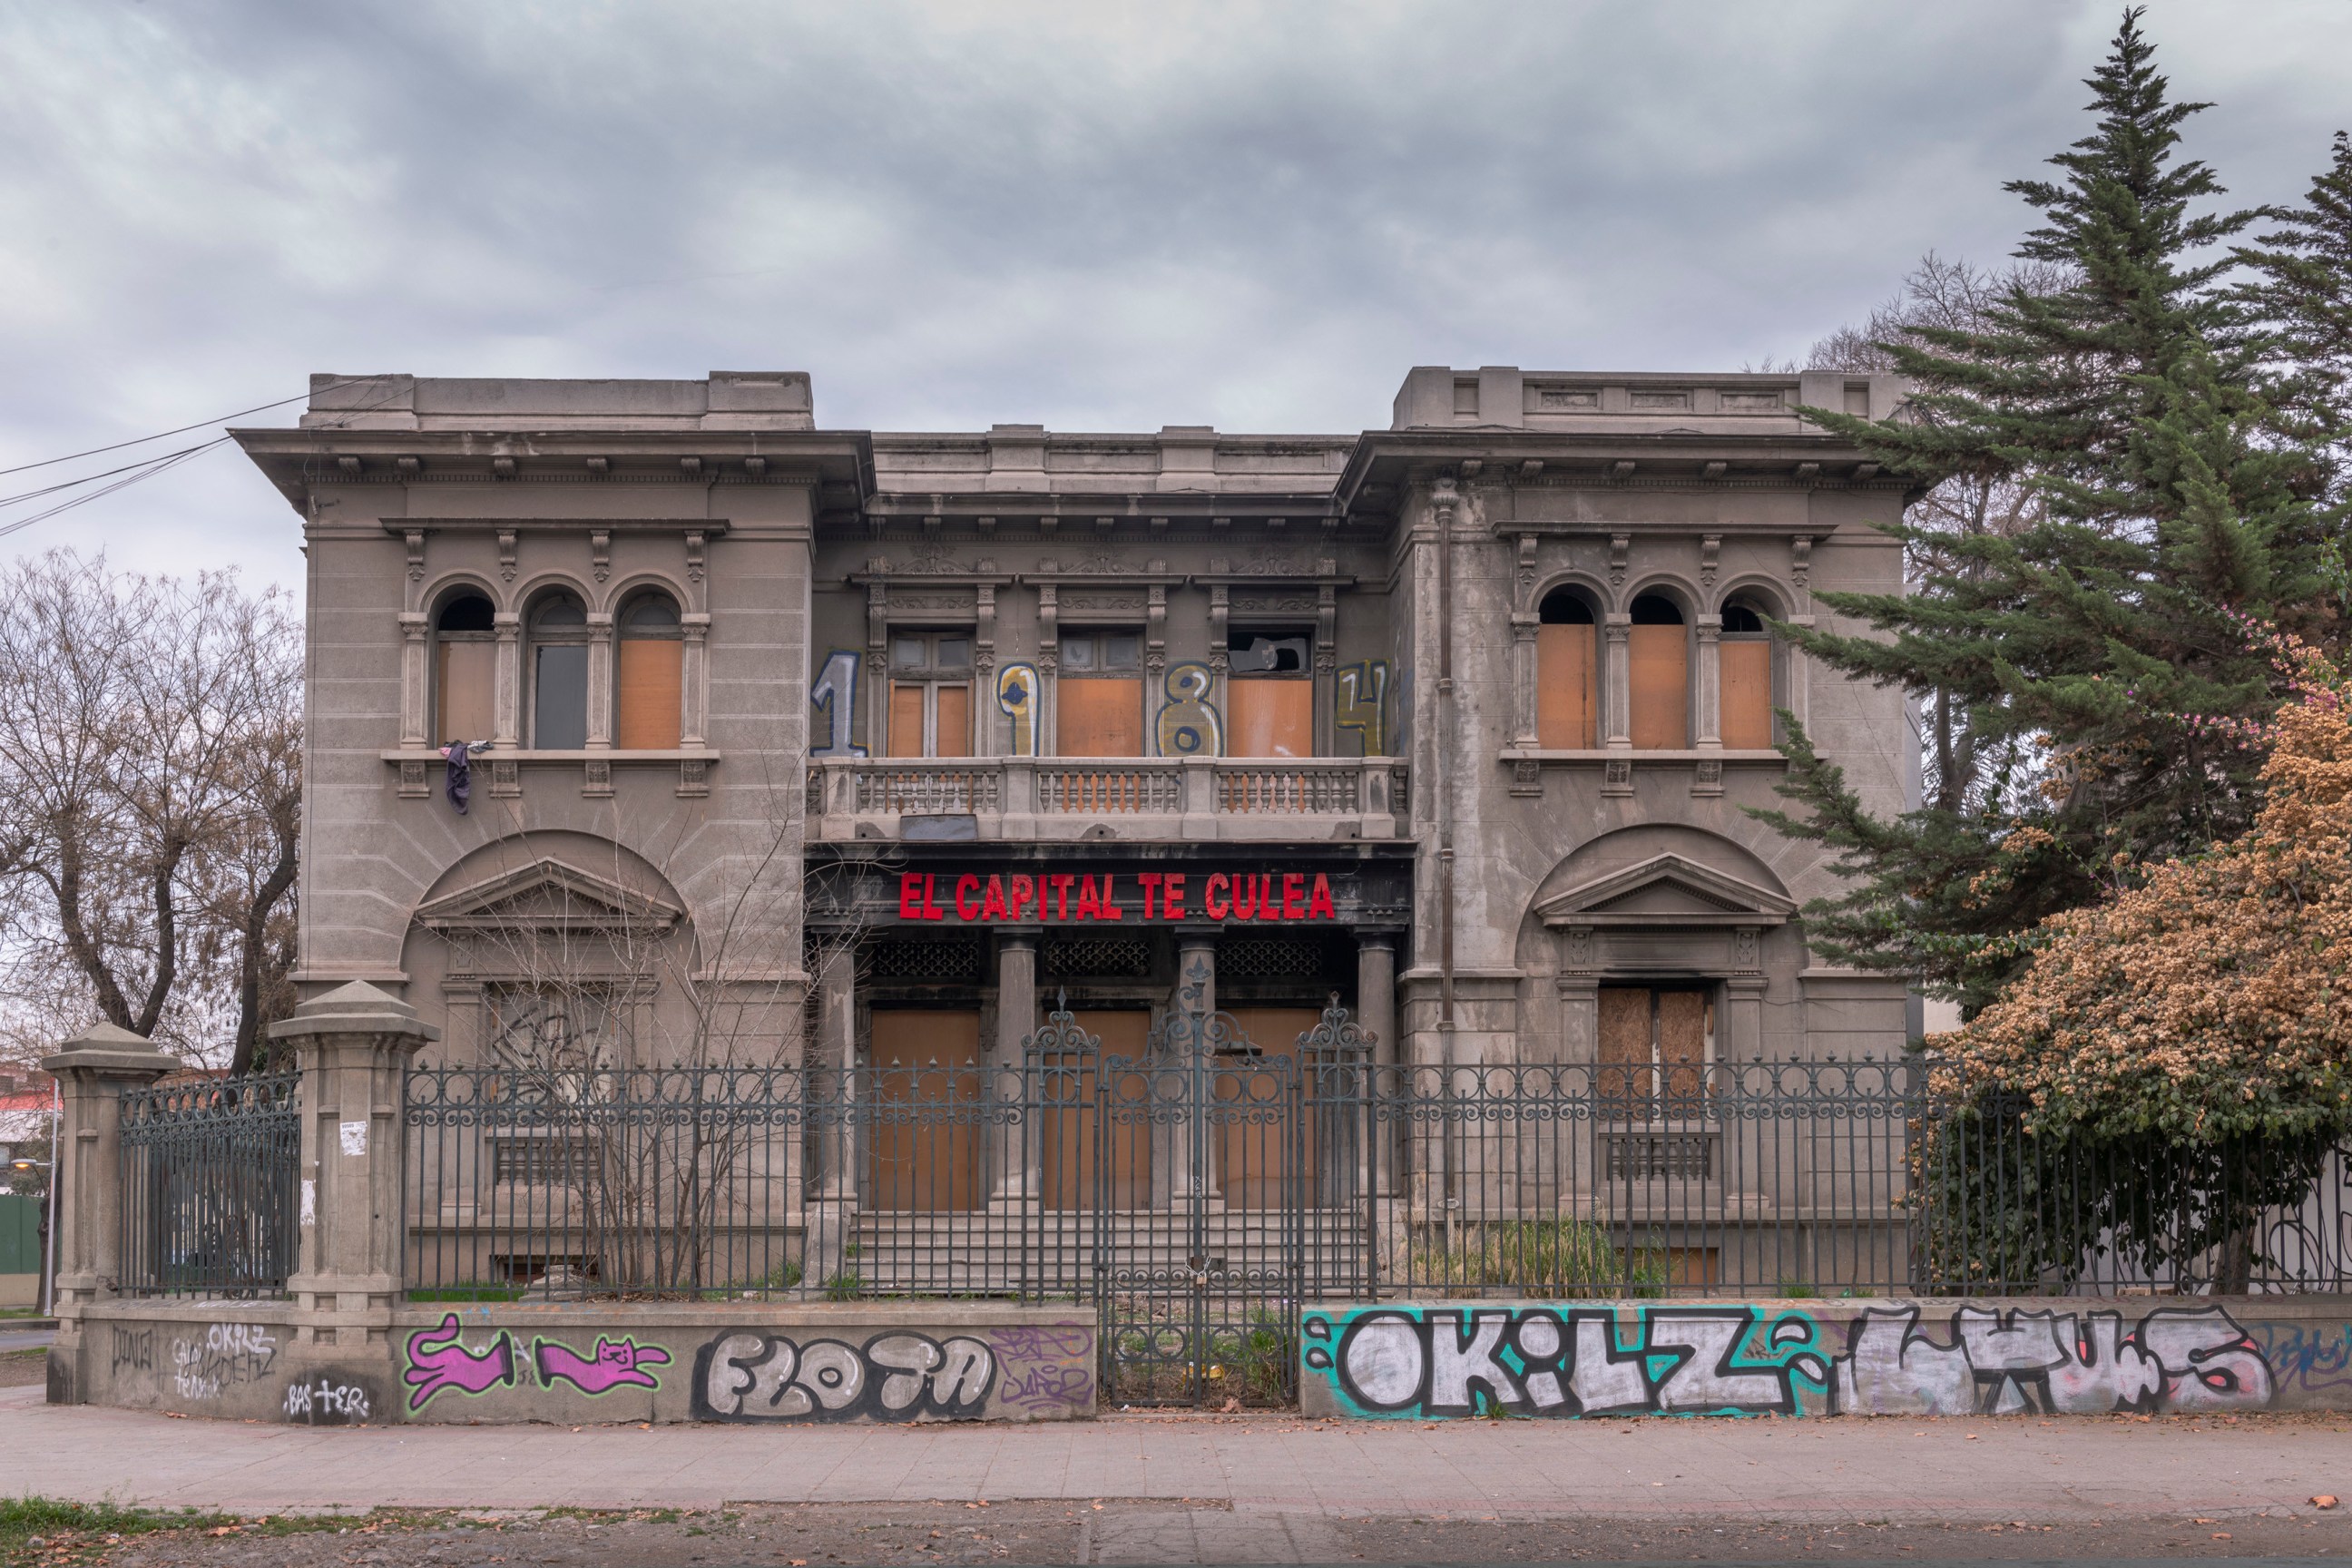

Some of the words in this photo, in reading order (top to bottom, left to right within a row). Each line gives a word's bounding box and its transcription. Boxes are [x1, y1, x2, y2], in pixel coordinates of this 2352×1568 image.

[899, 873, 943, 921] EL
[955, 874, 1122, 921] CAPITAL
[1138, 873, 1186, 919] TE
[1204, 873, 1336, 921] CULEA
